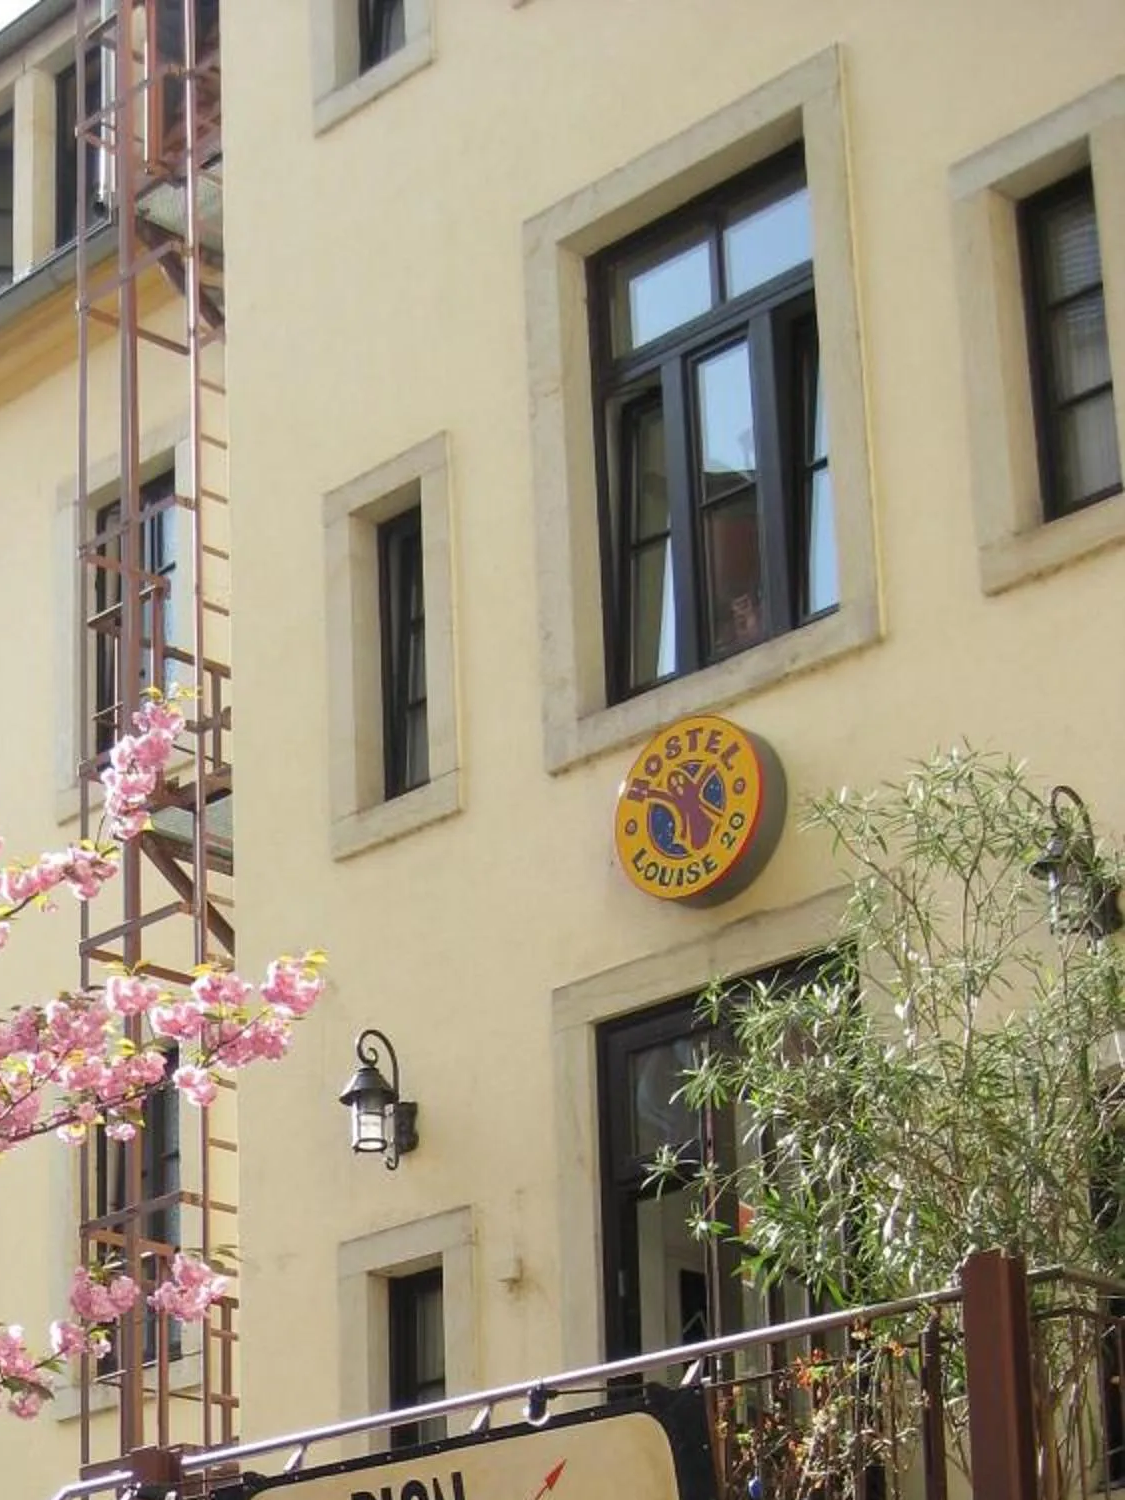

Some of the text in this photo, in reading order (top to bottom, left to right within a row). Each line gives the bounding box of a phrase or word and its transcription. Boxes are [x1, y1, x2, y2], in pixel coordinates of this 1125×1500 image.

[627, 728, 740, 802] HOSTEL
[632, 812, 745, 887] LOUISE 20
